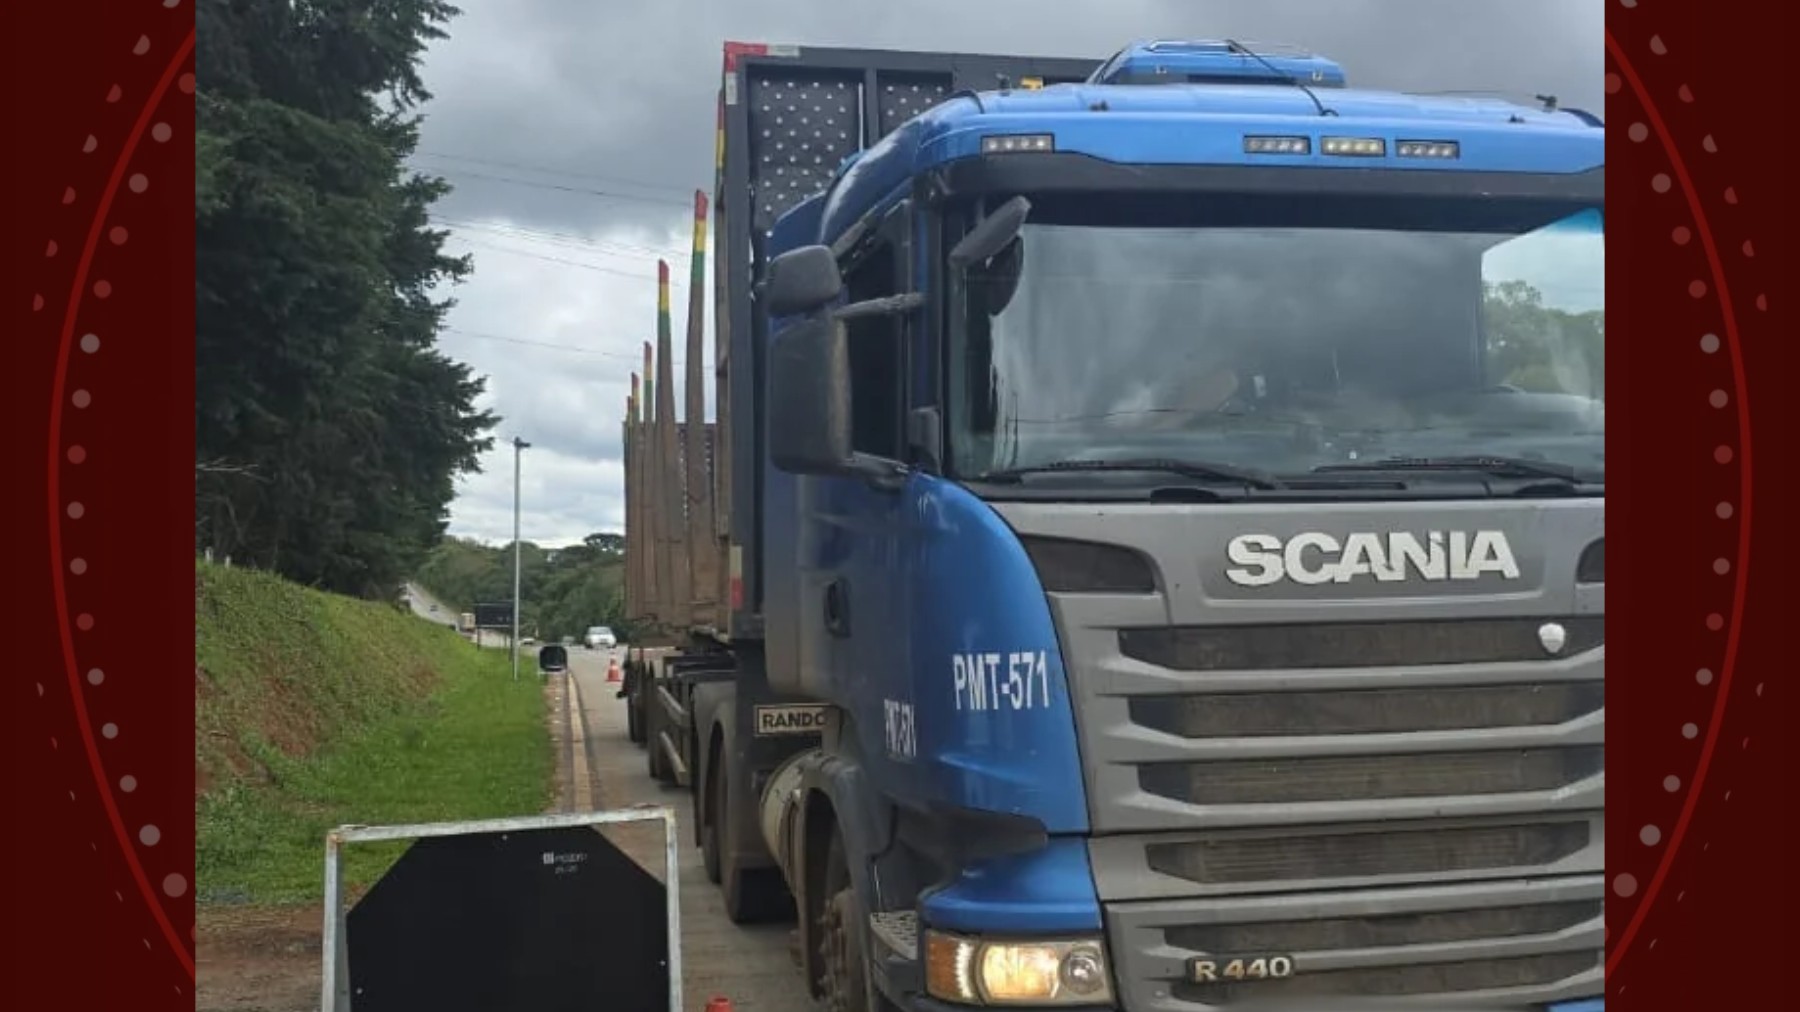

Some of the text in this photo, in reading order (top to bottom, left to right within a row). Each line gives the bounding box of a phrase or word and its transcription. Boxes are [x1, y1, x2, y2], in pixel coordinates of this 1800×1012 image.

[1226, 530, 1521, 586] SCANIA
[952, 651, 1049, 710] PMT-571
[1195, 957, 1291, 982] R 440
